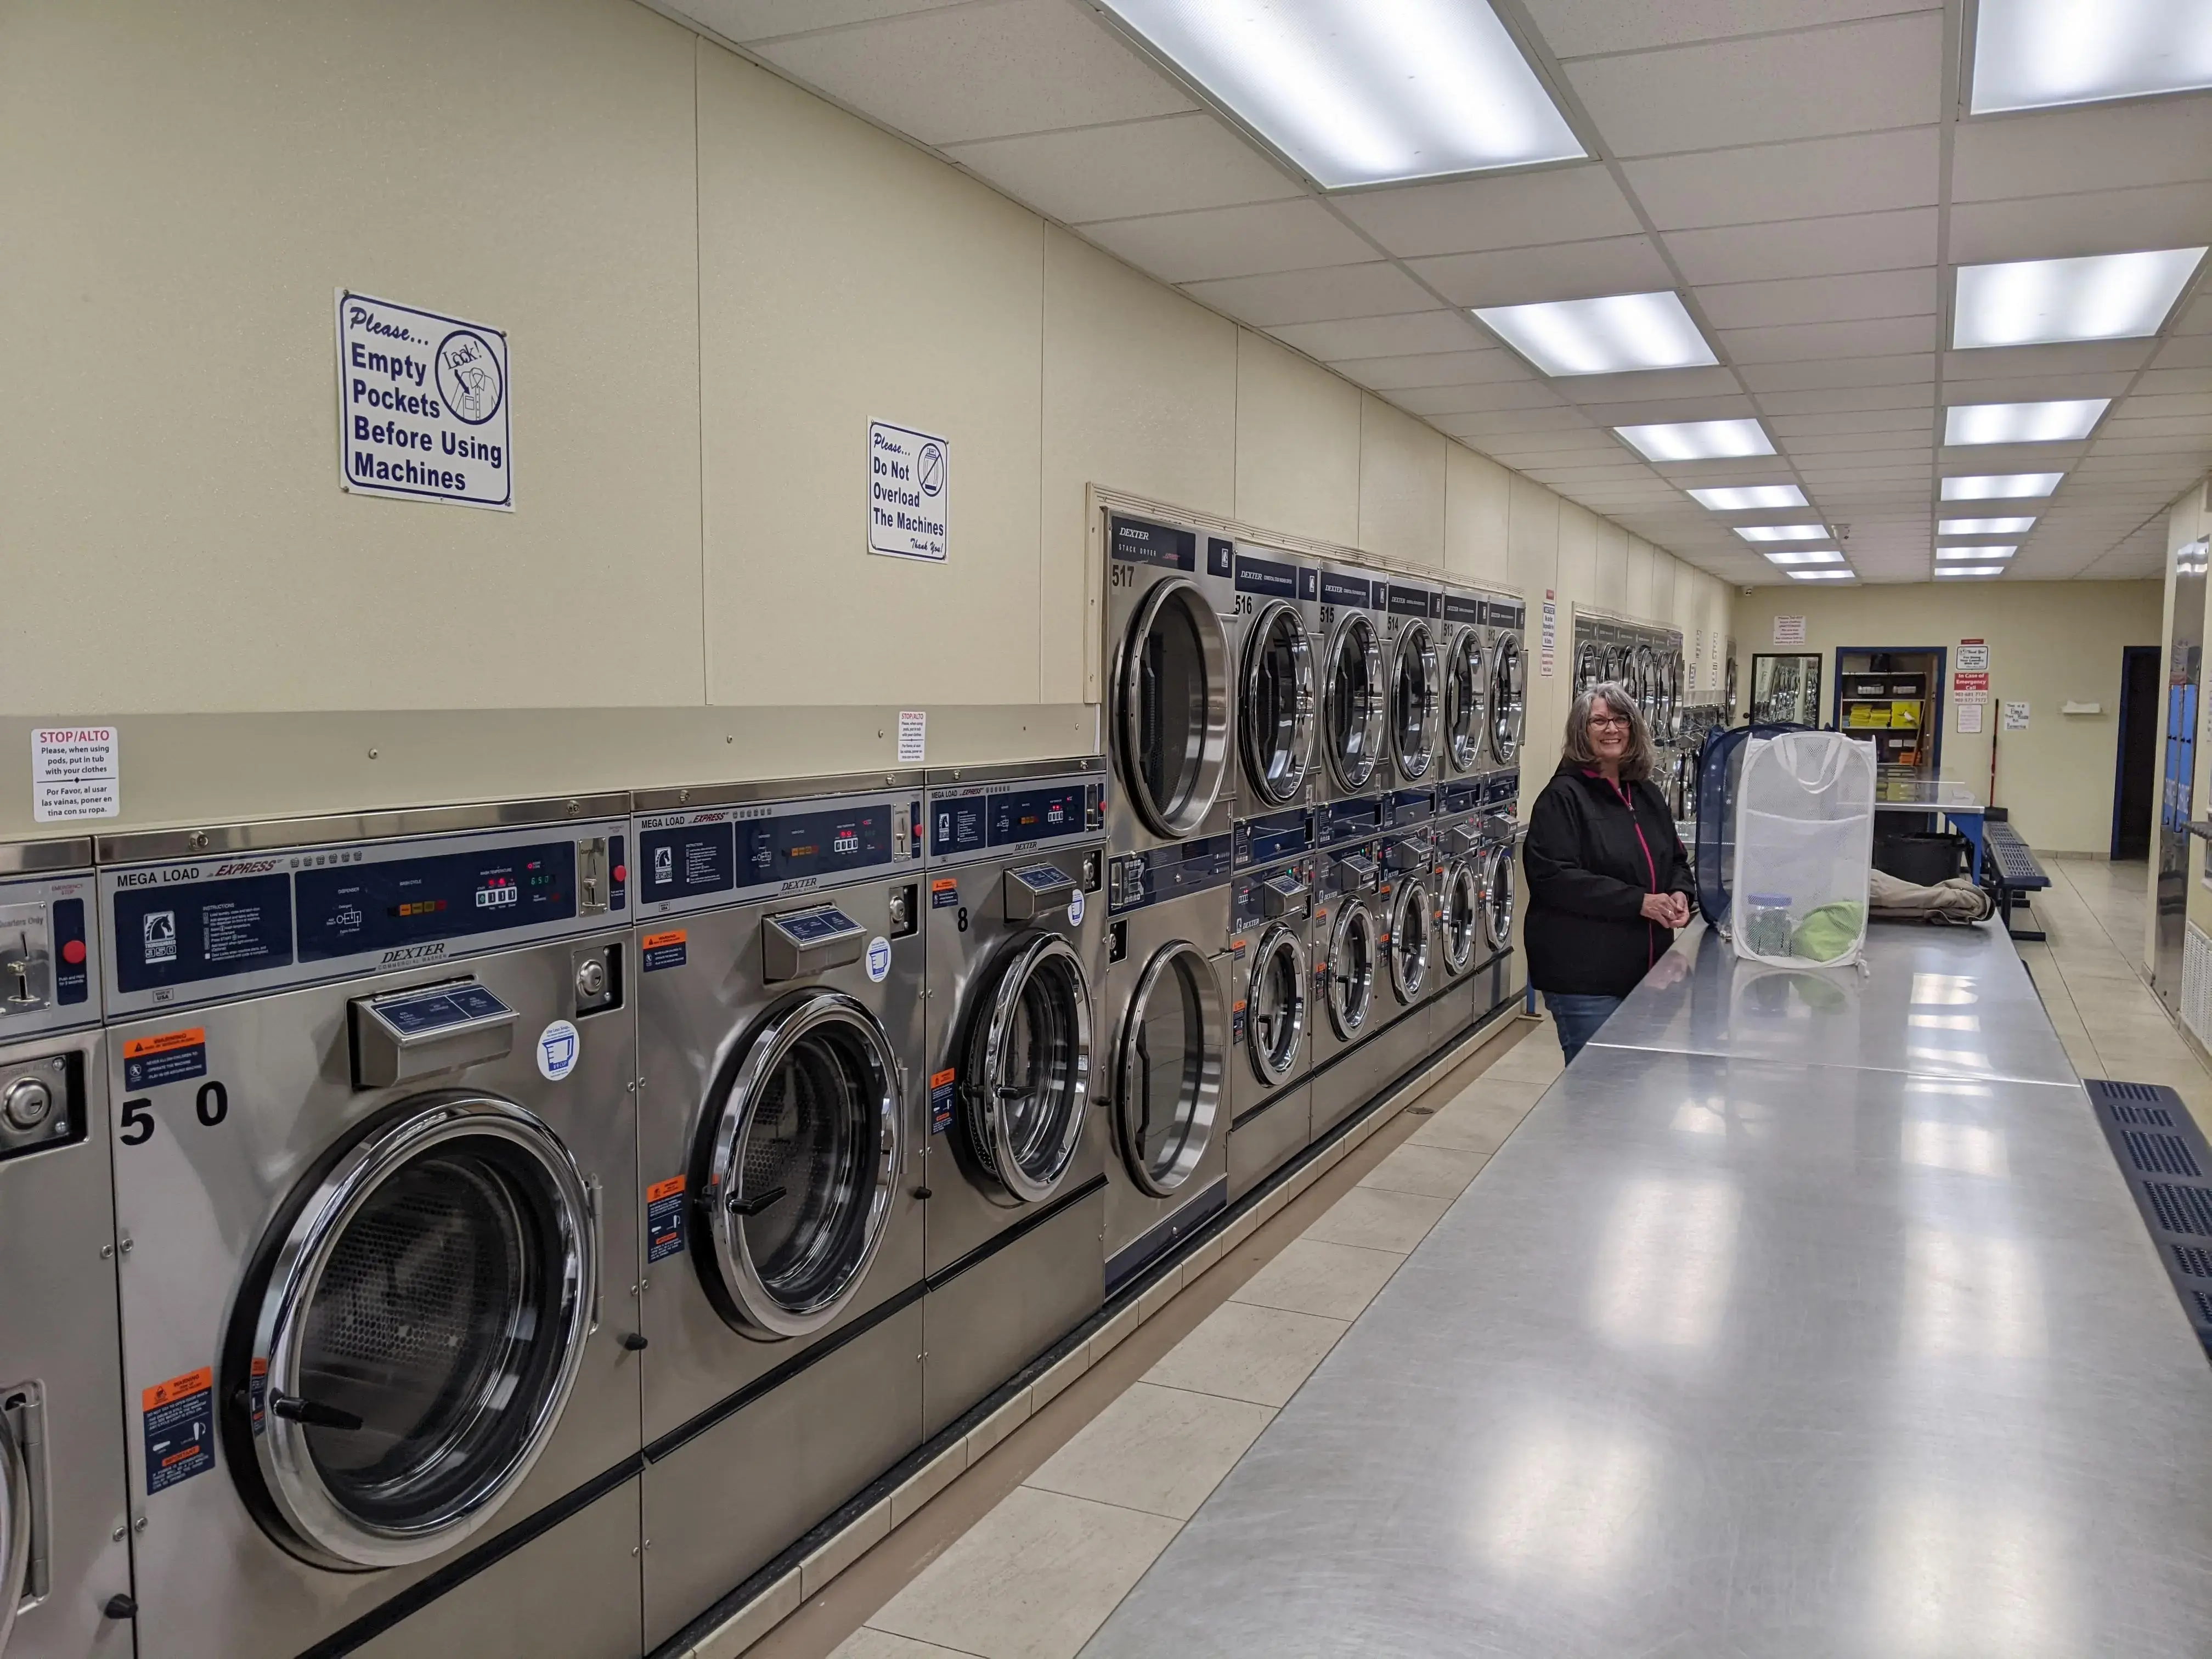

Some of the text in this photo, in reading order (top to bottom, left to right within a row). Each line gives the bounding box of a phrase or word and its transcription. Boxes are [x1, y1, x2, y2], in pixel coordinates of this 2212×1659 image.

[349, 306, 429, 346] Please...
[442, 341, 483, 370] Look!
[351, 341, 427, 387] Empty
[353, 378, 441, 419] Pockets
[354, 415, 501, 469] Before Using
[874, 433, 910, 456] Please...
[354, 452, 466, 491] Machines
[874, 456, 909, 481] Do Not
[873, 482, 919, 507] Overload
[873, 507, 943, 536] The Machines
[1119, 527, 1149, 540] DEXTER
[911, 538, 943, 554] Thank You!
[1119, 544, 1136, 553] STACK
[1140, 548, 1156, 557] DRYER
[1112, 565, 1134, 588] 517
[1240, 571, 1262, 580] DEXTER
[1325, 585, 1342, 593] DEXTER
[1235, 595, 1252, 614] 516
[1320, 607, 1334, 623] 515
[1387, 617, 1398, 631] 514
[1444, 624, 1453, 636] 513
[40, 730, 109, 743] STOP/ALTO
[48, 757, 67, 766] pods,
[641, 812, 725, 828] MEGA LOAD EXPRESS
[1014, 842, 1037, 850] DEXTER
[117, 860, 277, 887] MEGA LOAD EXPRESS
[781, 878, 816, 891] DEXTER
[1324, 891, 1338, 900] DEXTER
[28, 916, 43, 926] Only
[958, 907, 968, 932] 8
[1243, 918, 1260, 929] DEXTER
[381, 943, 445, 963] DEXTER
[377, 953, 447, 970] COMMERCIAL WASHER
[154, 1033, 187, 1043] WARNING
[120, 1081, 228, 1146] 5 0
[174, 1374, 199, 1387] WARNING
